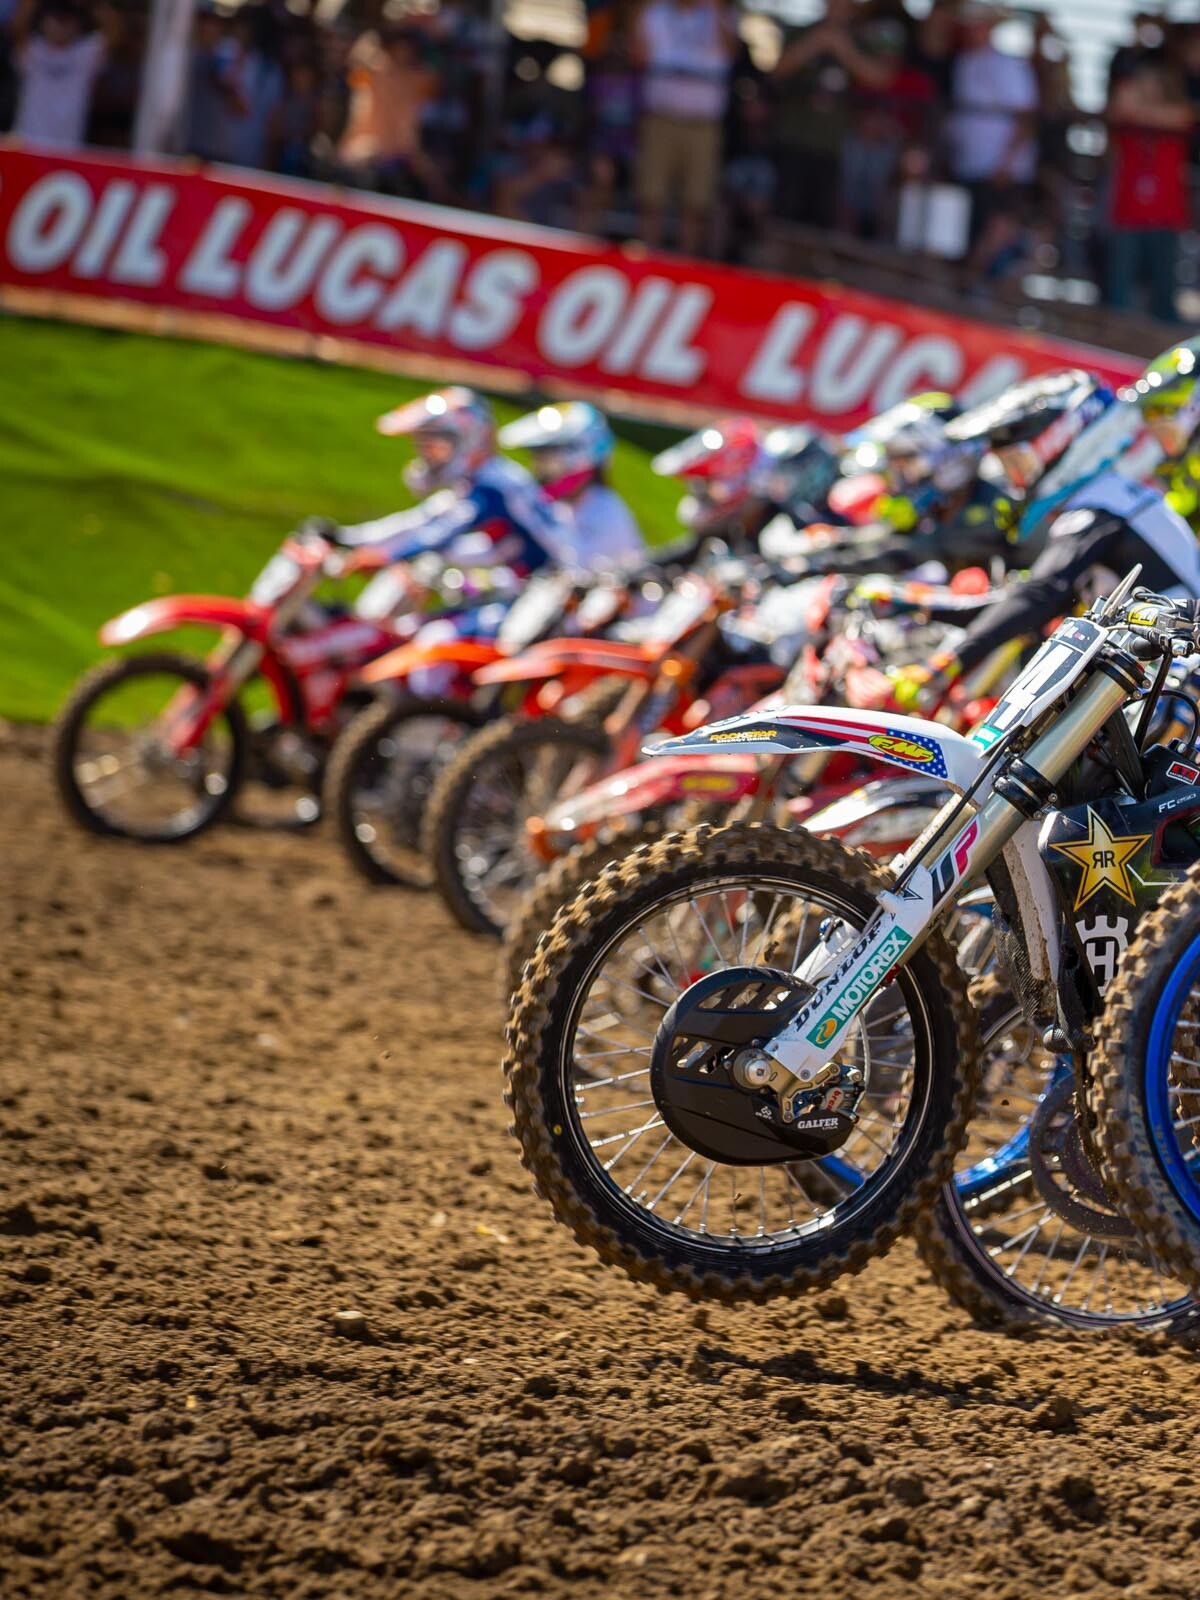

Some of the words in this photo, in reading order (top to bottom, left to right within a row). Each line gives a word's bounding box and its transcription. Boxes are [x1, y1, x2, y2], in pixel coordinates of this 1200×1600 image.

[7, 168, 176, 287] OIL
[178, 196, 538, 350] LUCAS
[538, 264, 713, 386] OIL
[710, 730, 777, 742] ROCKSTAR
[875, 737, 933, 762] FMF
[795, 923, 881, 1033] DUNLOP
[831, 930, 909, 1022] MOTOREX
[797, 1118, 839, 1129] GALFER
